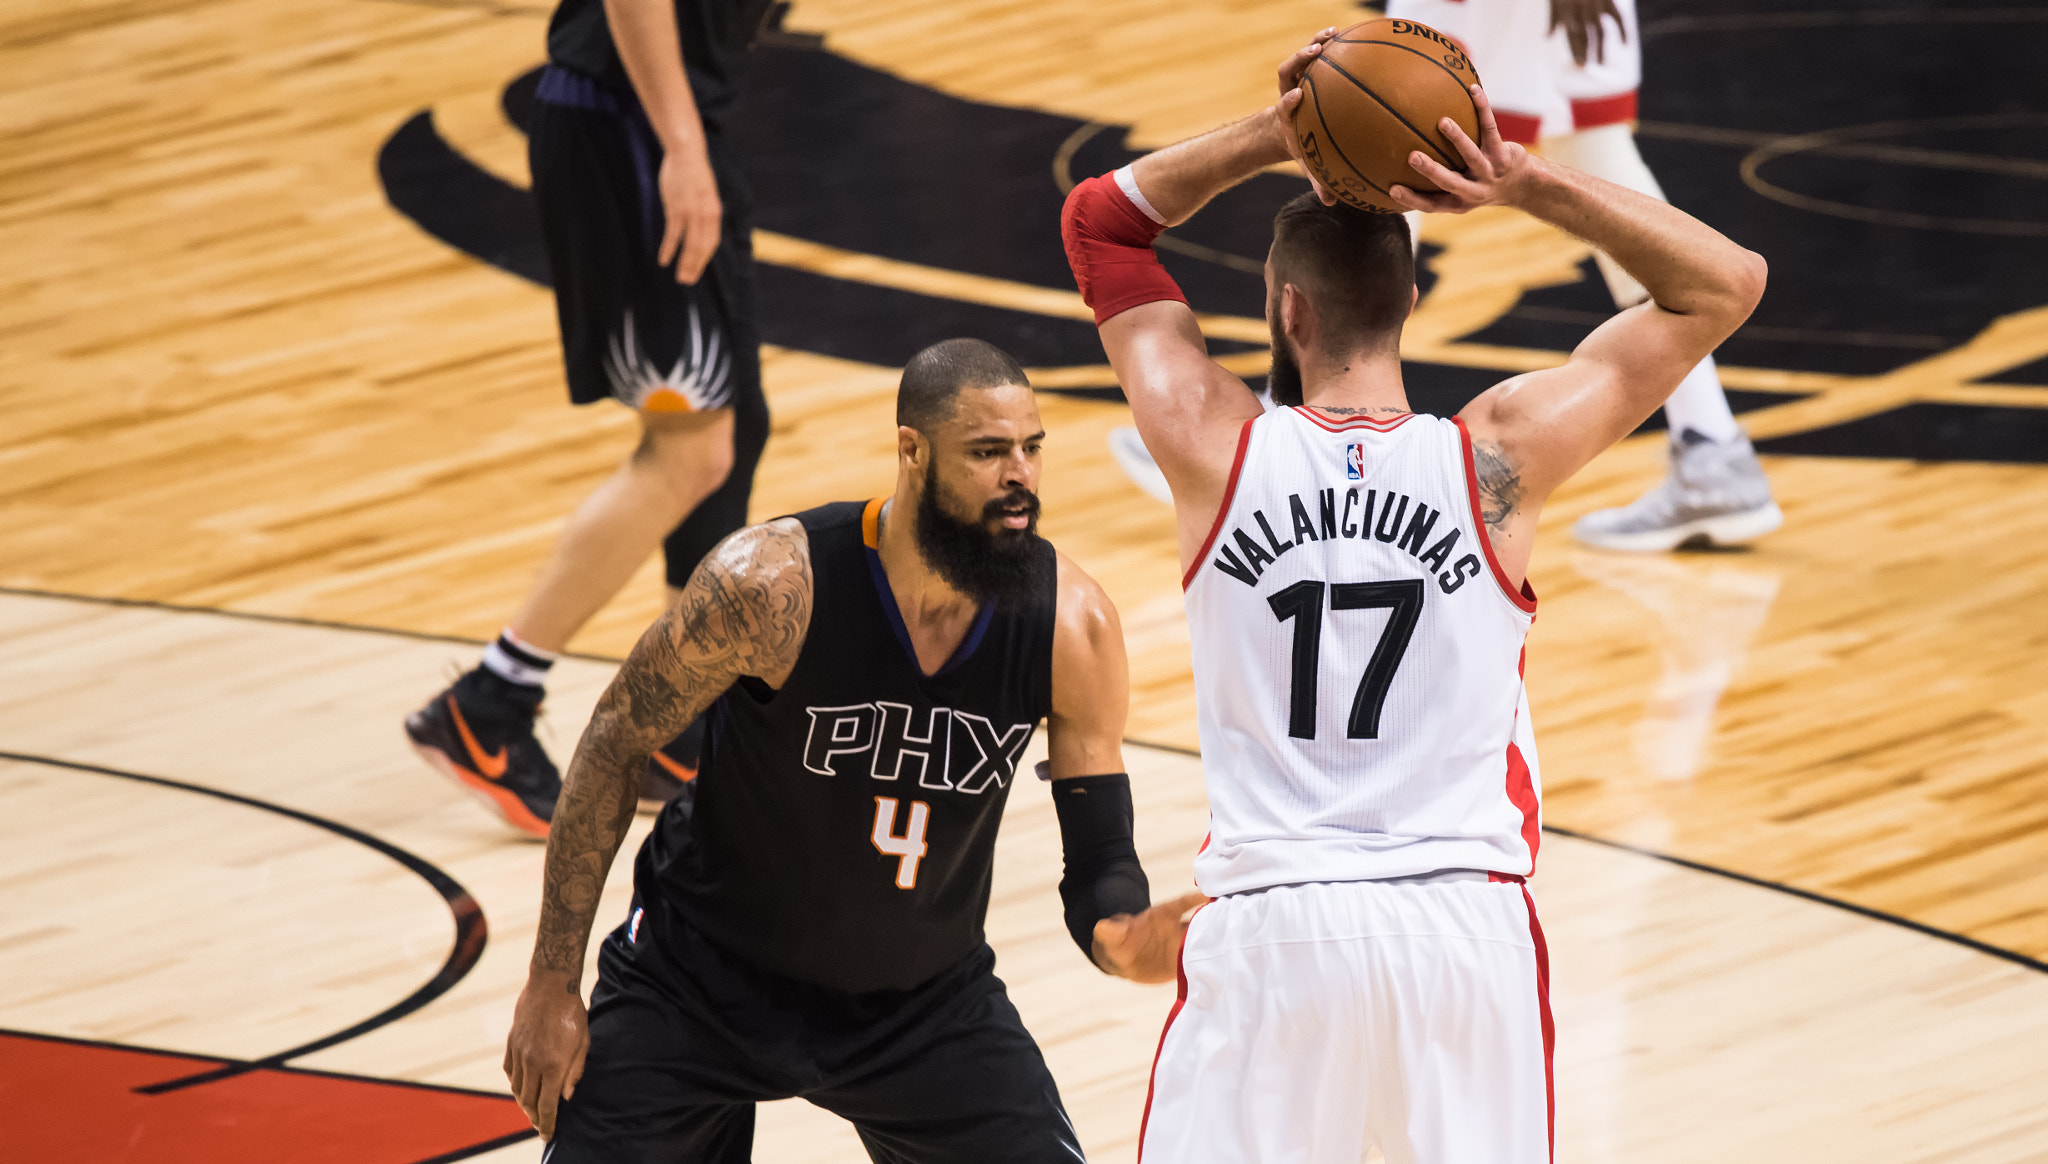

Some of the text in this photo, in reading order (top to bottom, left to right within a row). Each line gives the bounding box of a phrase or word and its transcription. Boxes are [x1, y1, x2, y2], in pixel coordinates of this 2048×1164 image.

[1214, 487, 1481, 595] VALANCIUNAS
[1266, 579, 1424, 740] 17
[803, 700, 1032, 794] PHX
[870, 796, 931, 889] 4
